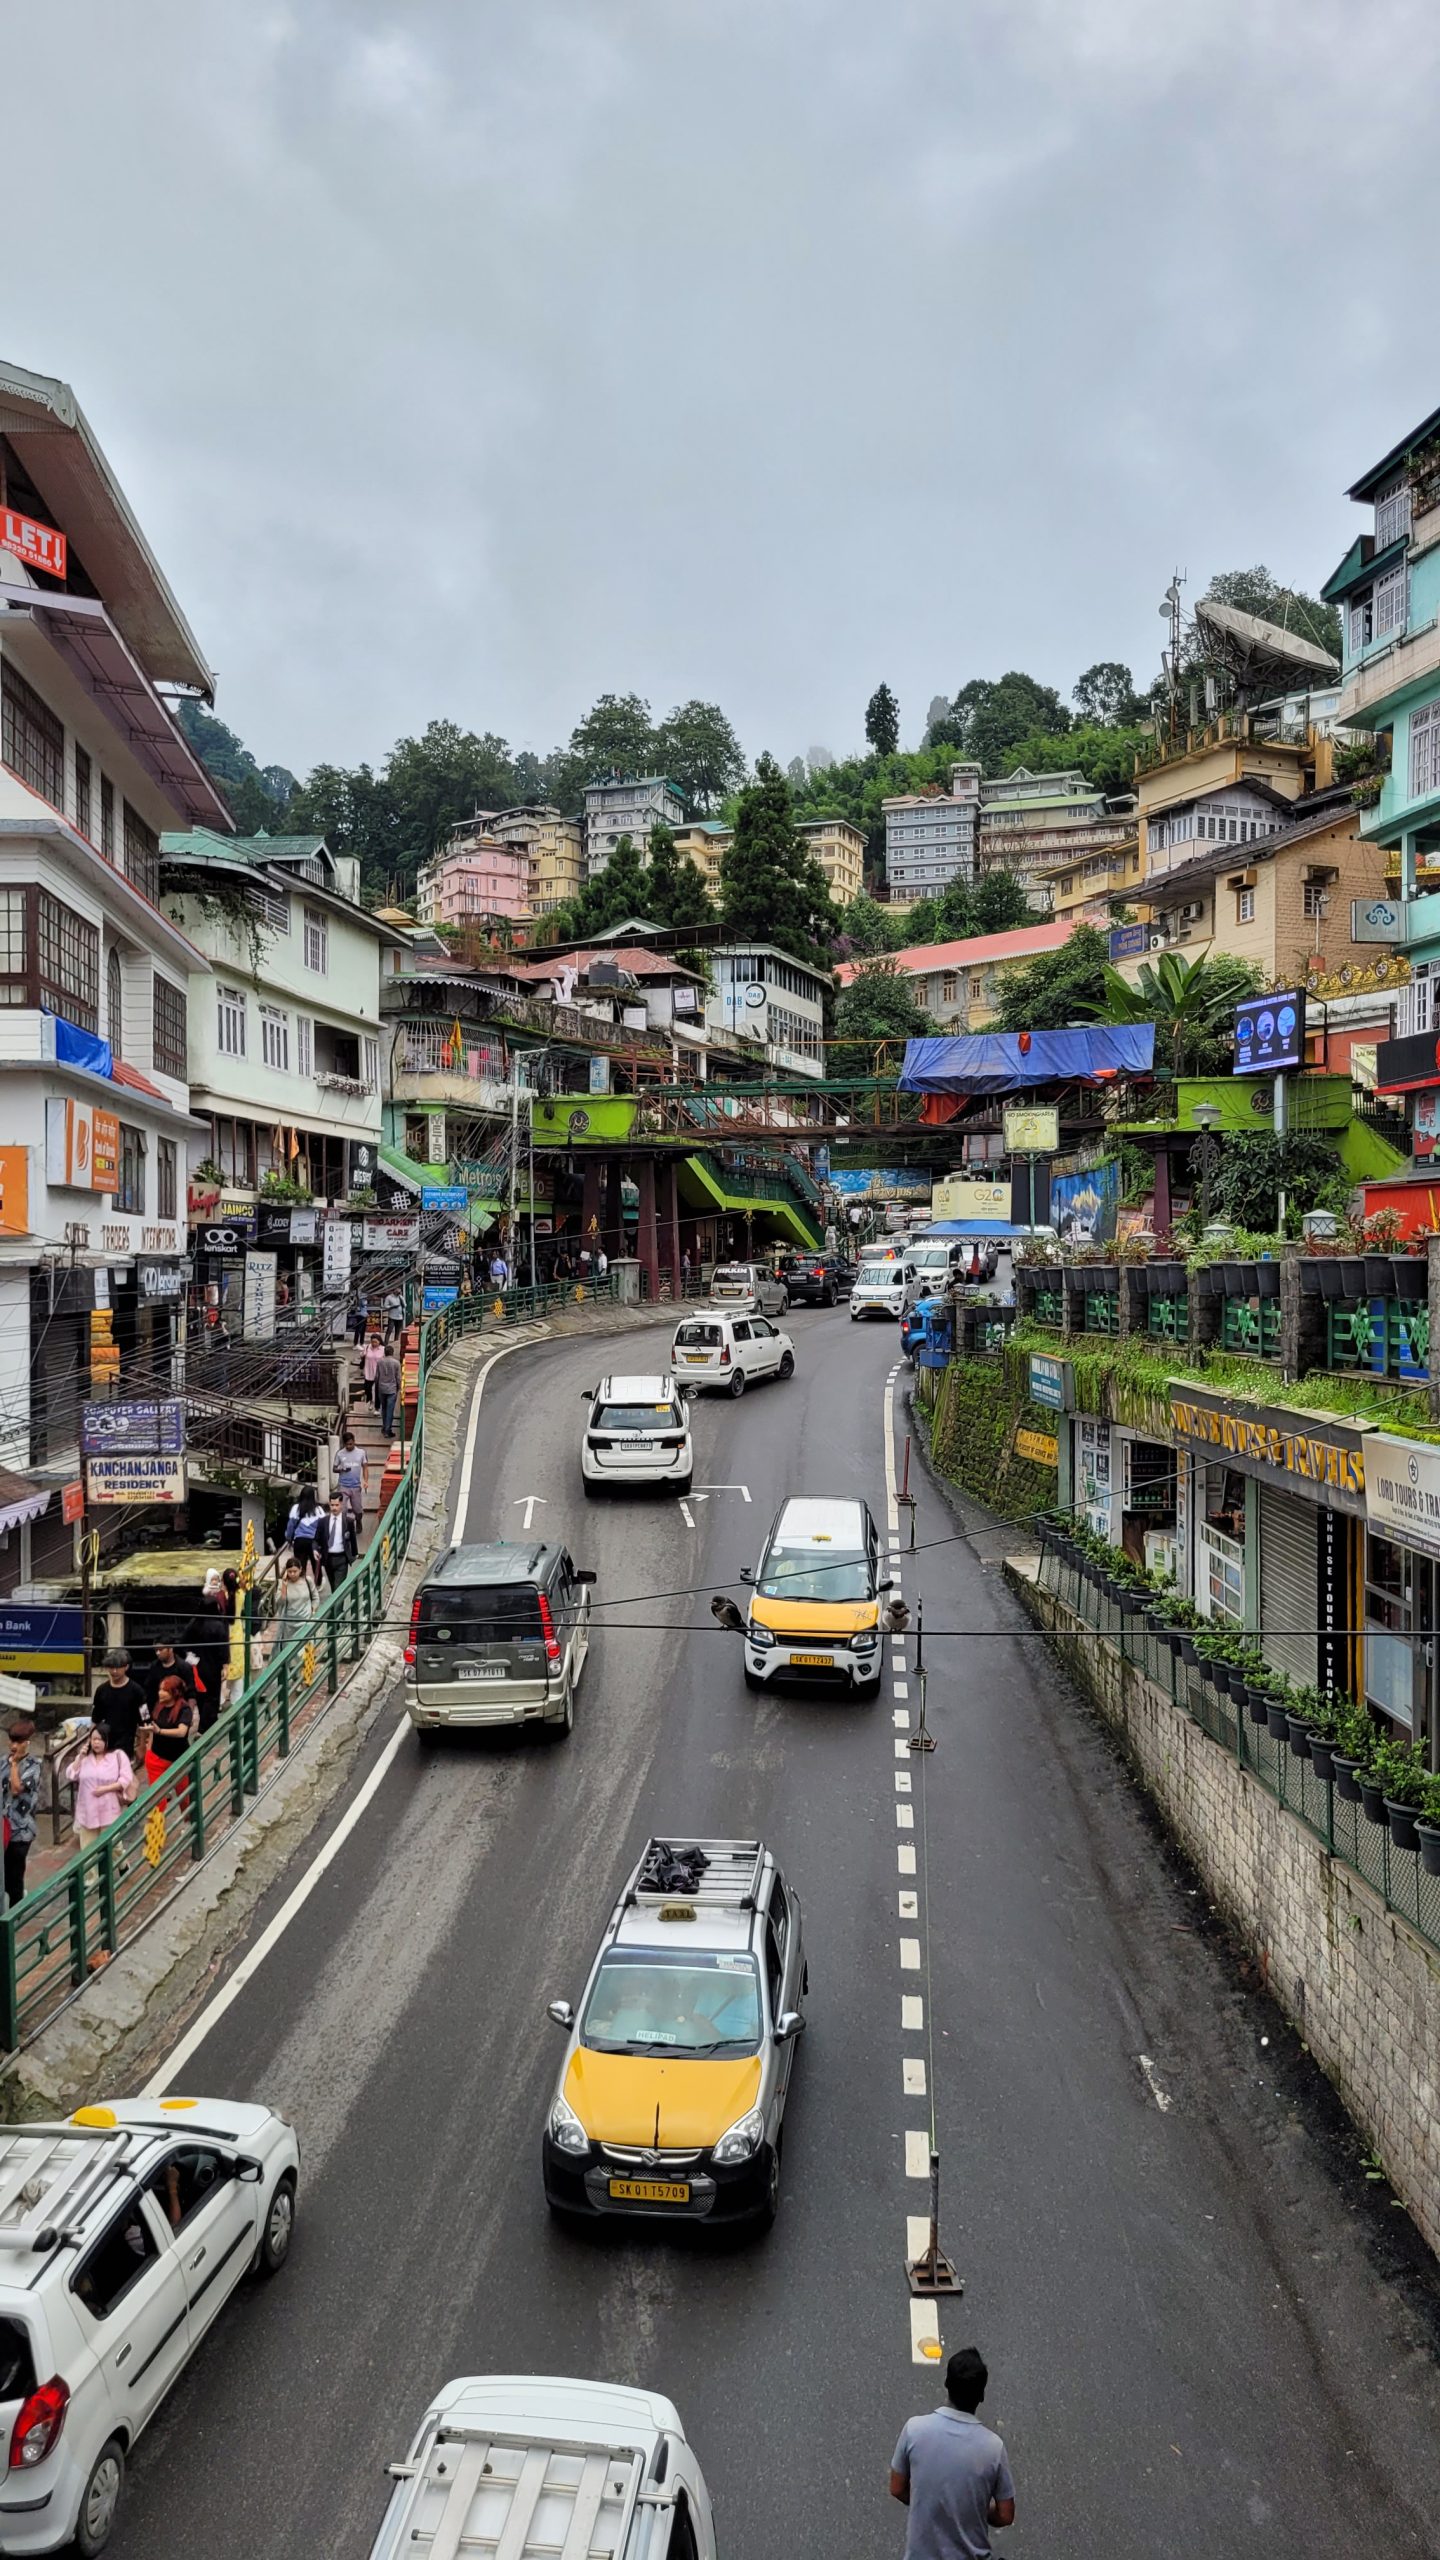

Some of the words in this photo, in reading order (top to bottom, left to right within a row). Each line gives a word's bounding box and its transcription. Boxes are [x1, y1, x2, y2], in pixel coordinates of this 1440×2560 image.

[6, 514, 52, 557] LET
[726, 996, 743, 1006] DB
[431, 1114, 443, 1162] METRO
[221, 1203, 254, 1217] JAINCO
[204, 1244, 238, 1253] lenskart
[90, 1461, 179, 1477] KANCHANJANGA
[1281, 1431, 1365, 1495] TRAVELS
[104, 1480, 167, 1490] RESIDENCY
[1377, 1477, 1394, 1502] LORD
[1395, 1482, 1418, 1509] TOURS
[1326, 1582, 1334, 1632] TOURS
[5, 1620, 32, 1631] Bank
[1326, 1642, 1334, 1651] &
[666, 1909, 691, 1918] TAXI
